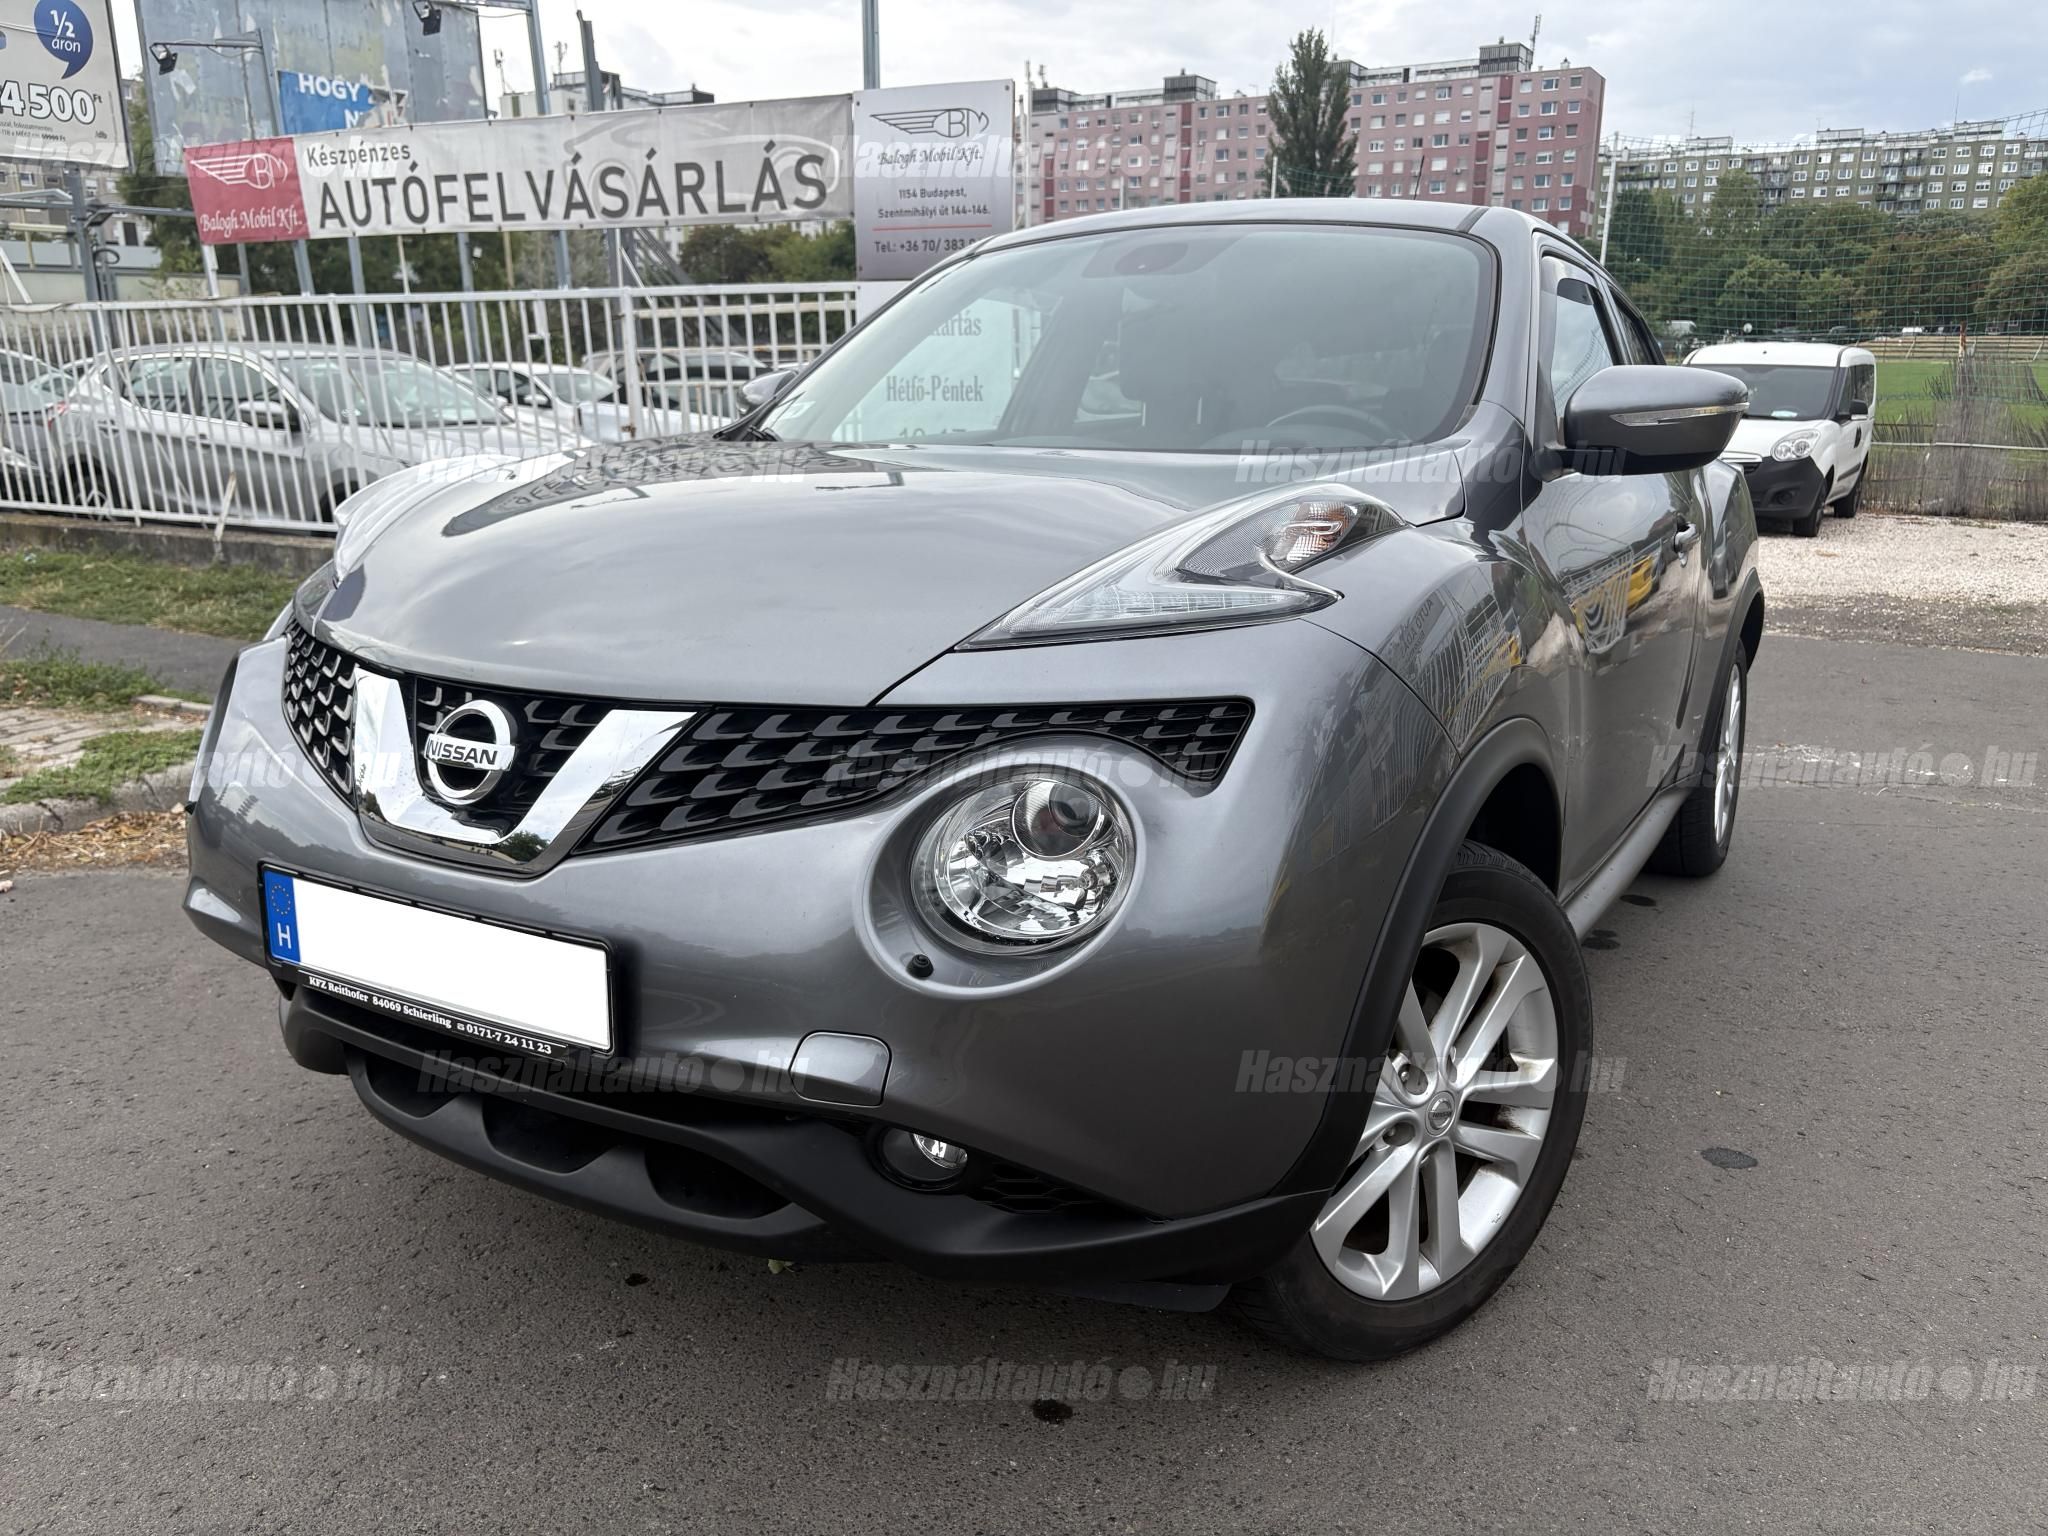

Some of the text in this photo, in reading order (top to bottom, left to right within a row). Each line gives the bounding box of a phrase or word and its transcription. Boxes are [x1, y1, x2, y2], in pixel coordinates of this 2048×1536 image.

[298, 73, 360, 102] HOGY
[307, 141, 411, 168] Készpénzes
[878, 147, 983, 169] Balogh Mobil Kft.
[319, 139, 828, 230] AUTÓFELVÁSÁRLÁS
[898, 187, 967, 200] 1154 Budapest,
[200, 204, 303, 238] Balogh Mobil Kft.
[877, 205, 991, 219] Szentmihályi út 144-146.
[899, 239, 919, 252] +36
[943, 238, 966, 251] 383
[885, 375, 984, 402] Hétfő-Péntek
[427, 740, 498, 766] NISSAN
[277, 922, 292, 950] H
[309, 976, 552, 1055] KFZ Reithofer 84069 Schierling 0171-7 24 11 23
